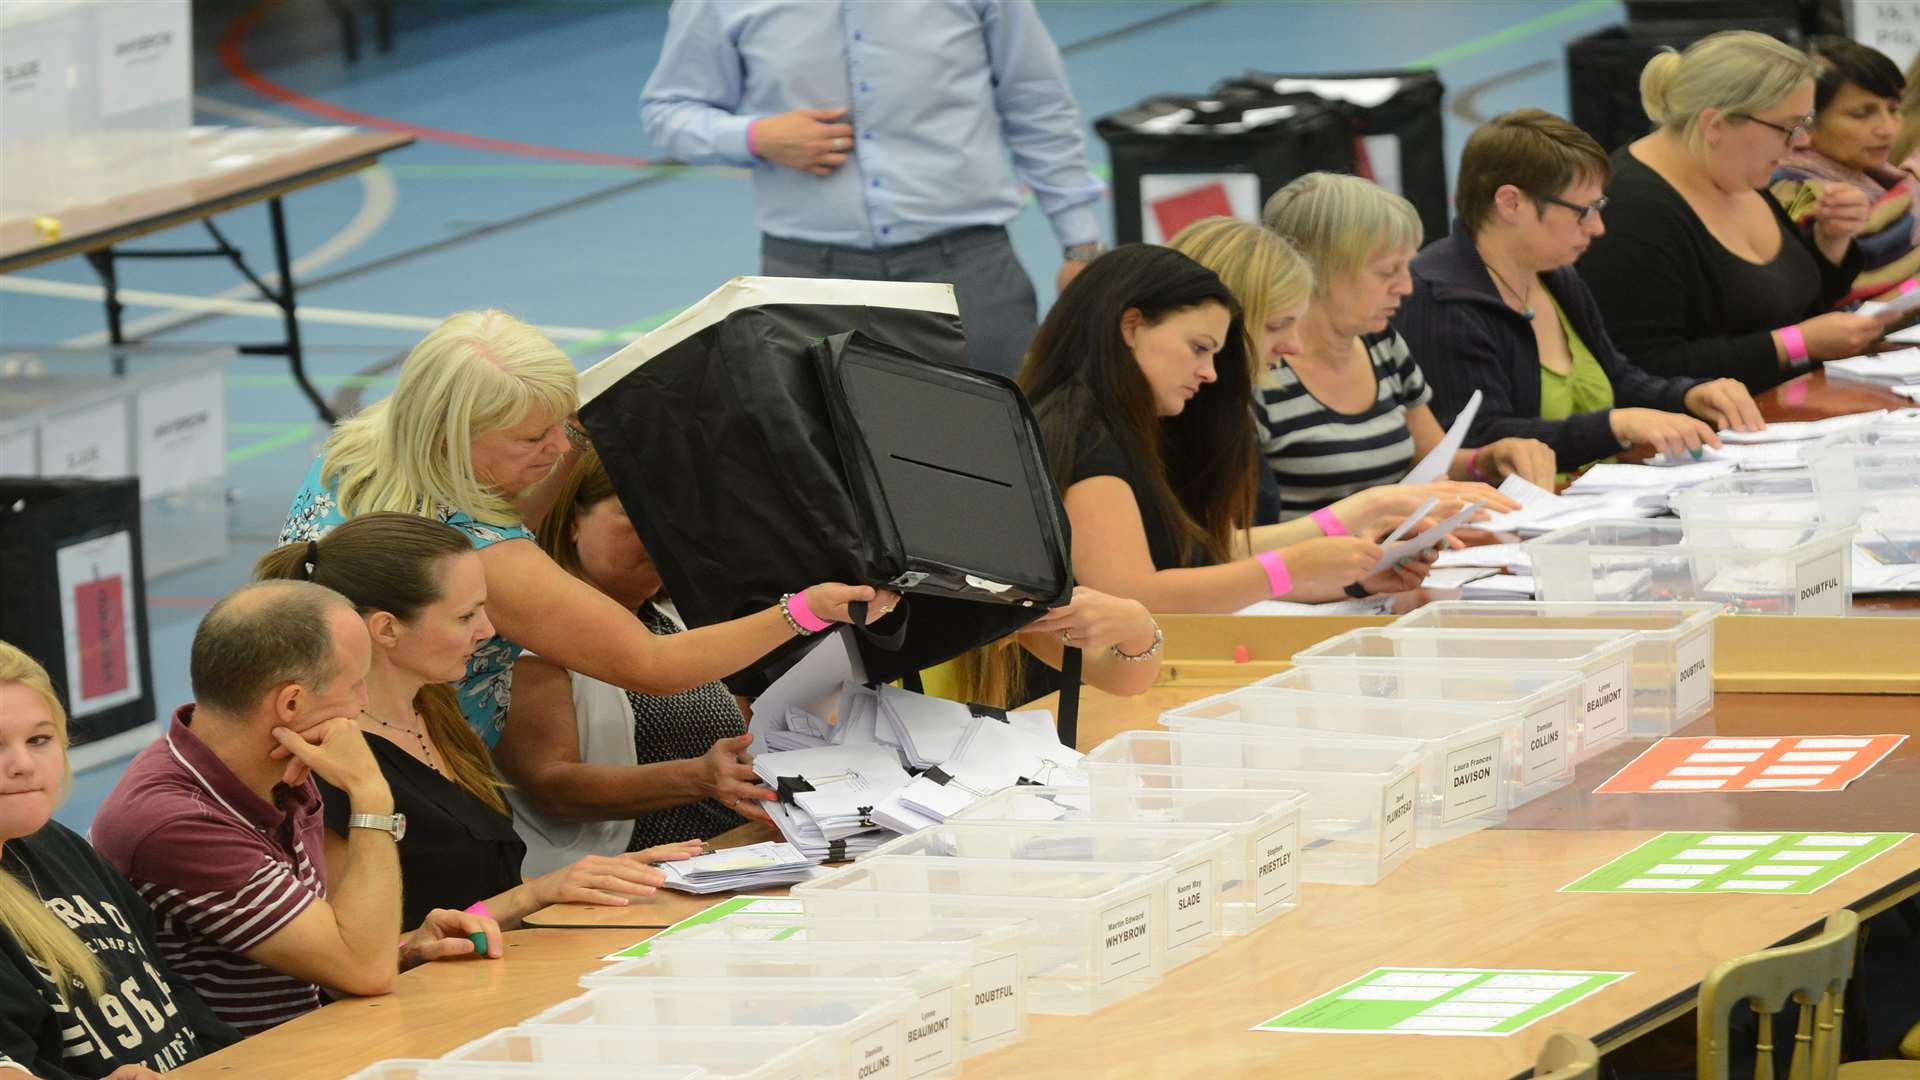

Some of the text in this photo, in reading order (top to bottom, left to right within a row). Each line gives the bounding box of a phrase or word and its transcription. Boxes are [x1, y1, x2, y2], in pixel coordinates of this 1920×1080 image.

[1801, 577, 1838, 600] DOUBTFUL
[1680, 659, 1705, 682] DOUBTFUL
[1586, 688, 1622, 712] BEAUMONT
[1530, 730, 1559, 751] COLLINS
[1453, 754, 1492, 773] Laura Frances
[1453, 766, 1491, 788] DAVISON
[1386, 800, 1412, 825] PLUMSTEAD
[1259, 852, 1291, 879] PRIESTLEY
[1178, 892, 1201, 911] SLADE
[1107, 911, 1144, 931] Martin Edward
[1105, 924, 1147, 949] WHYBROW
[975, 985, 1014, 1006] DOUBTFUL
[907, 1017, 950, 1043] BEAUMONT
[858, 1055, 890, 1080] COLLINS
